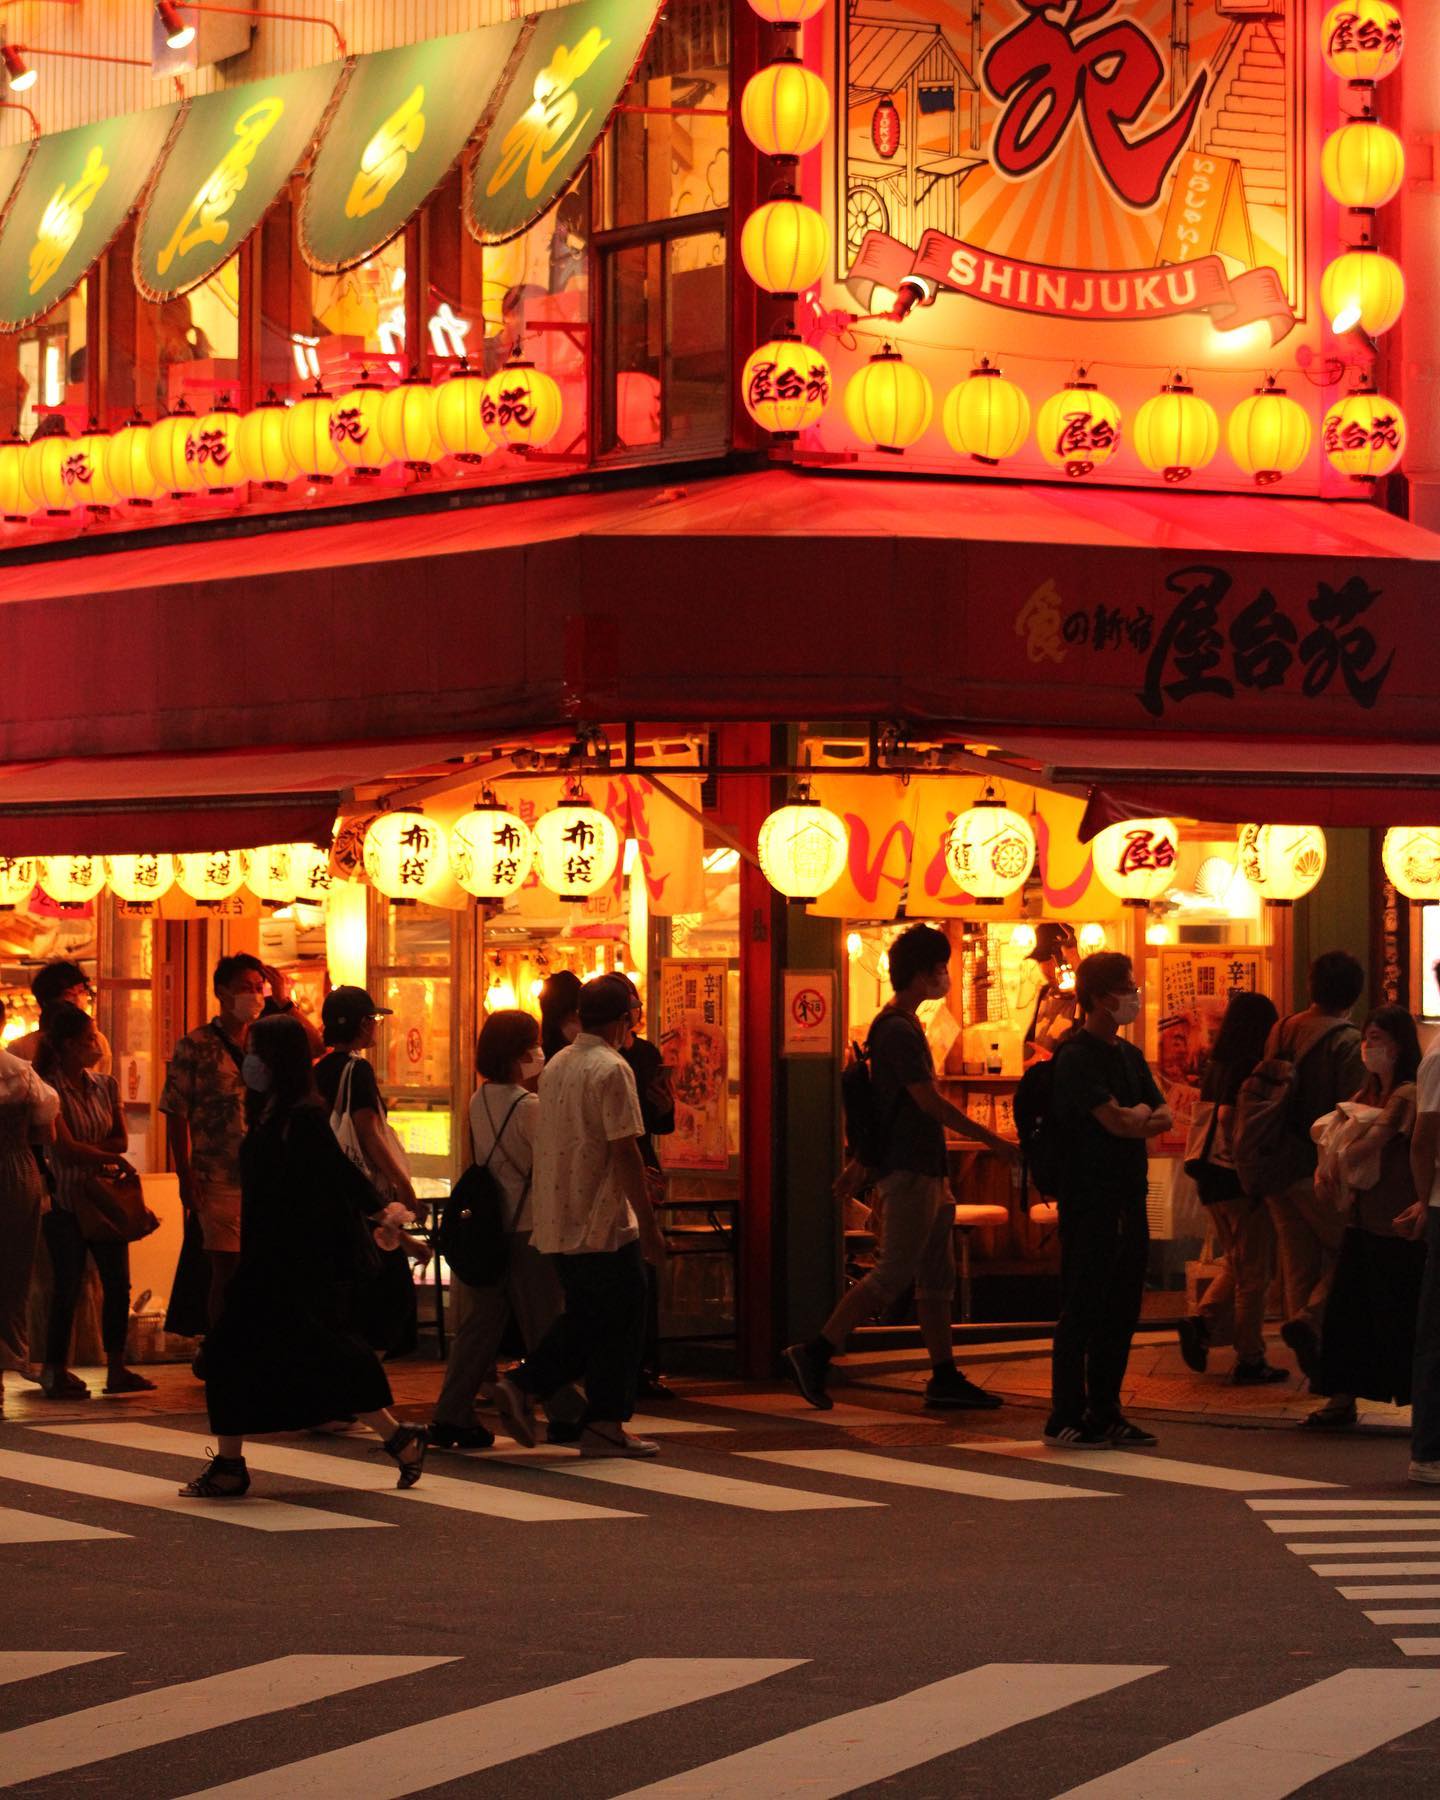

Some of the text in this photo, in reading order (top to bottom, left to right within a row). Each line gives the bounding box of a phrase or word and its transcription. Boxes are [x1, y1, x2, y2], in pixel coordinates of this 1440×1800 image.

[879, 107, 890, 152] TOKYO
[947, 249, 1198, 313] SHINJUKU
[750, 361, 829, 411] 屋台苑
[1325, 415, 1400, 454] 屋台苑
[493, 823, 521, 885] 布袋
[561, 820, 595, 884] 布袋
